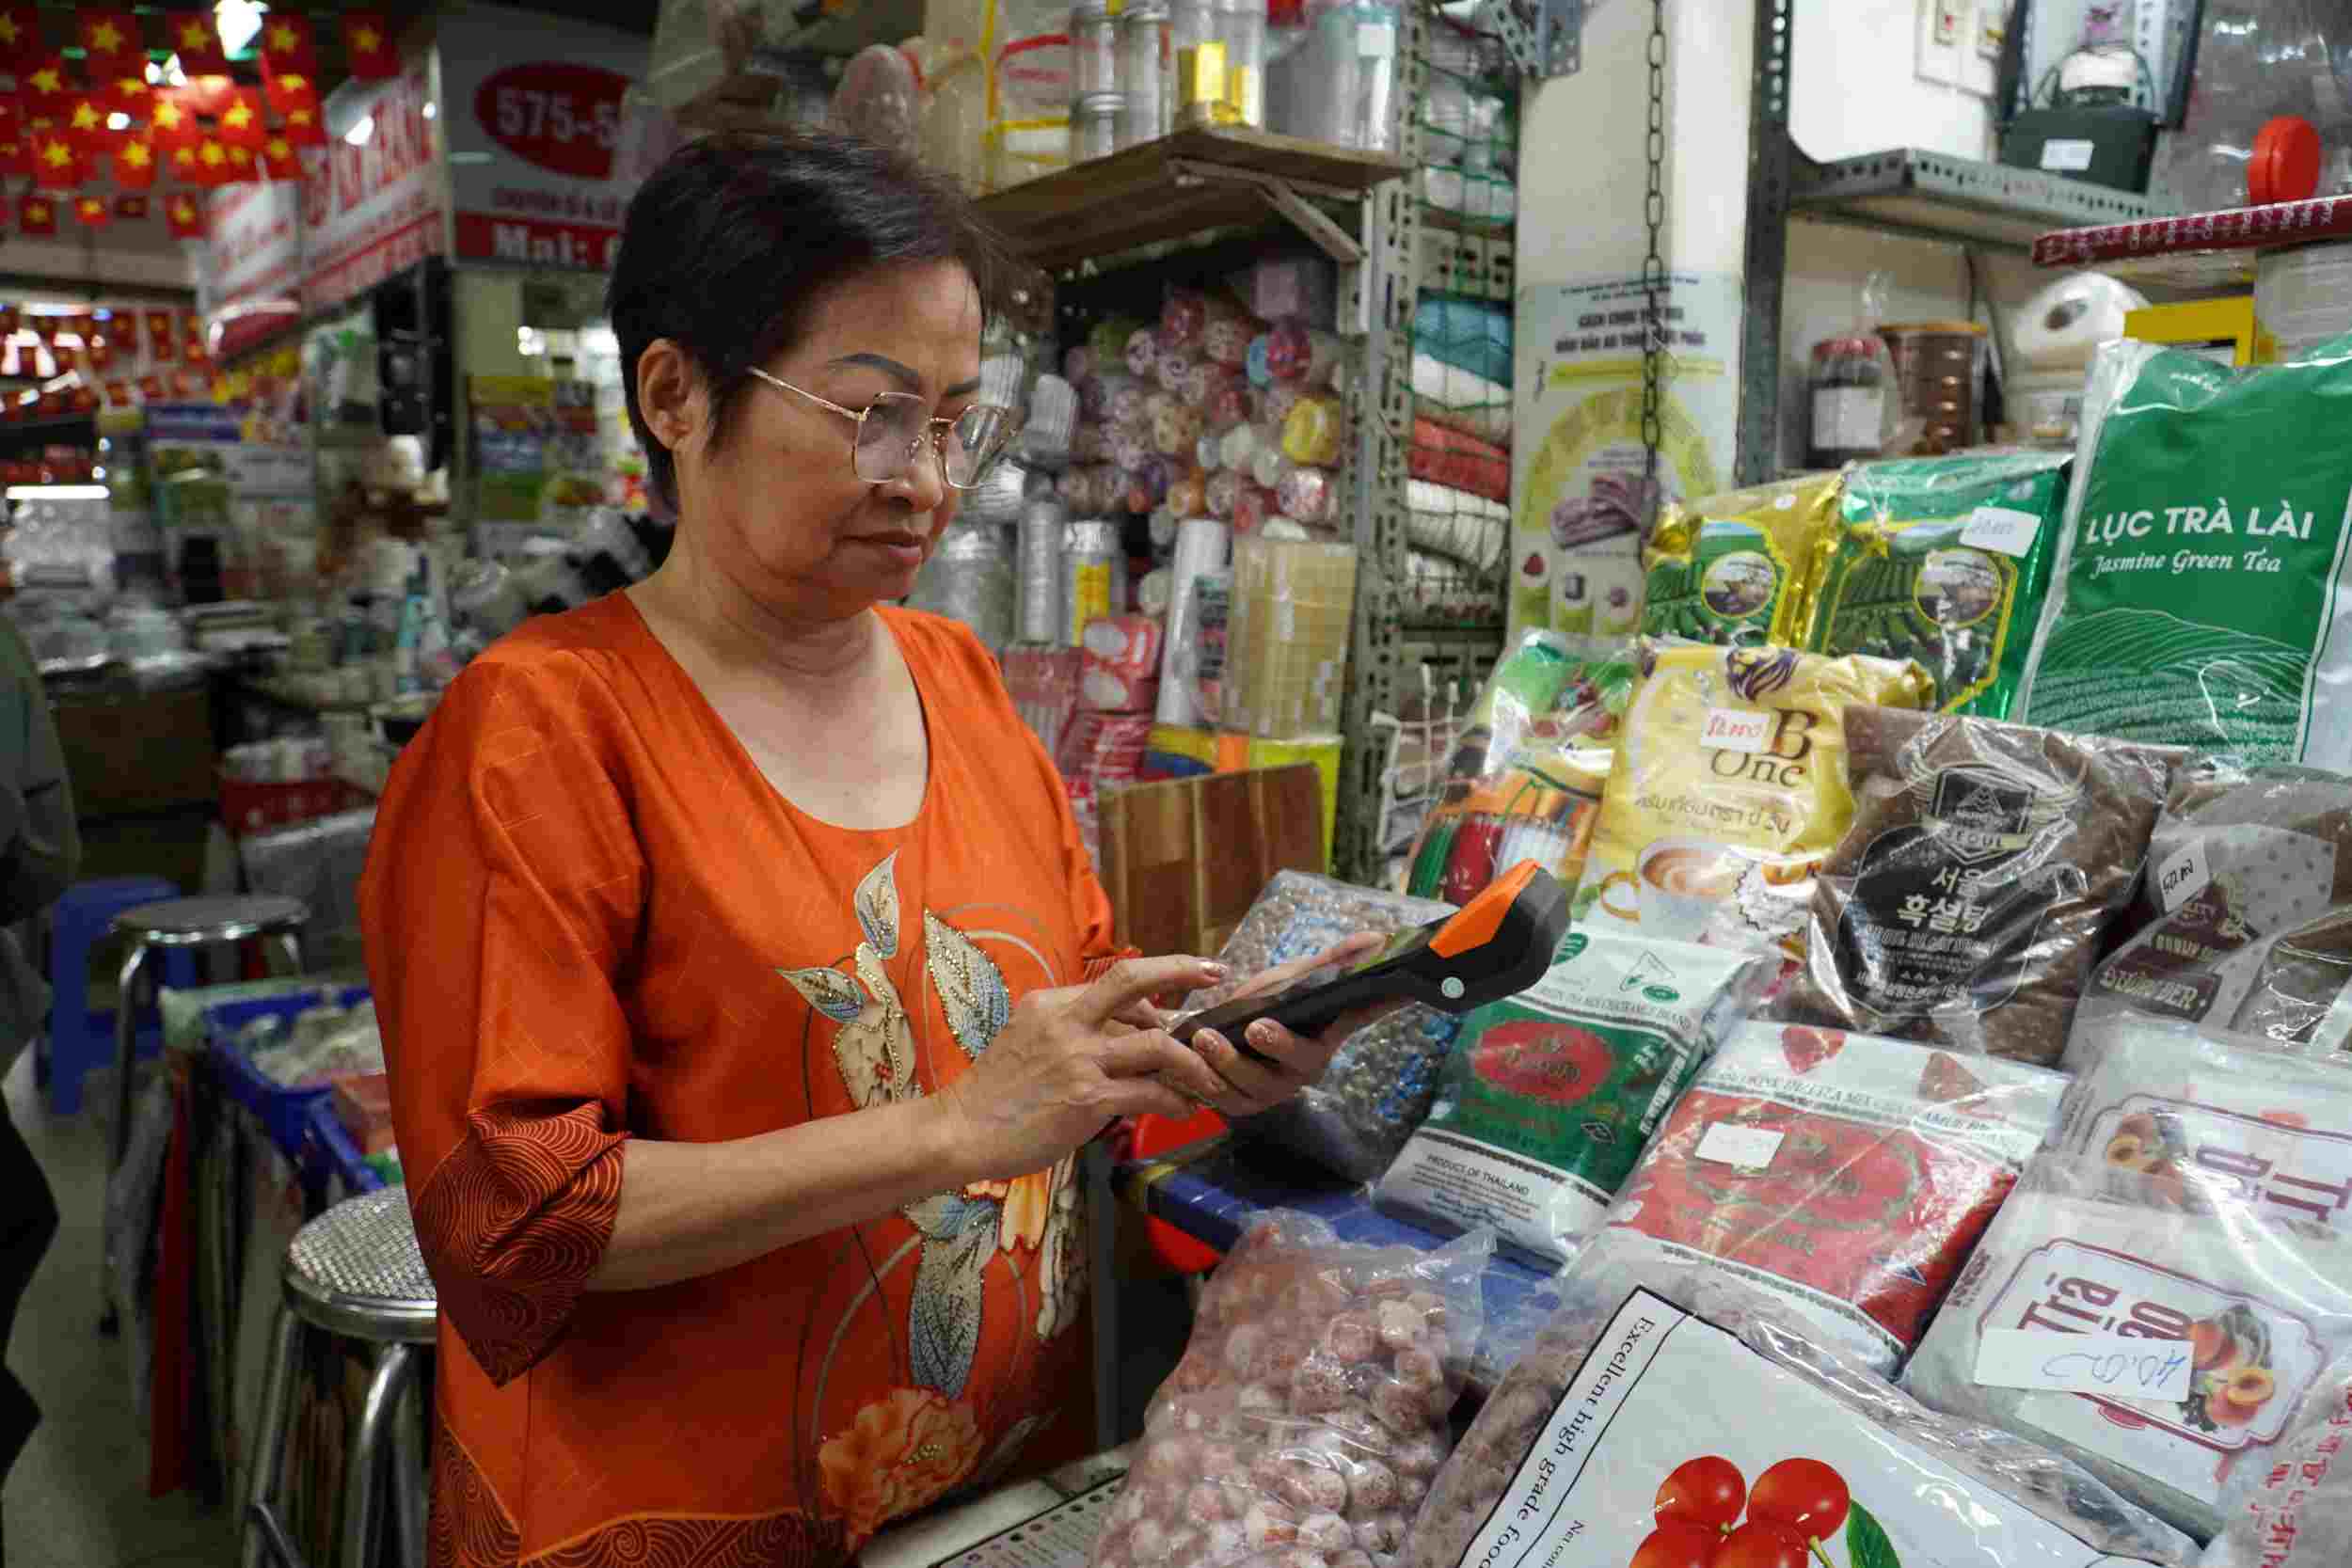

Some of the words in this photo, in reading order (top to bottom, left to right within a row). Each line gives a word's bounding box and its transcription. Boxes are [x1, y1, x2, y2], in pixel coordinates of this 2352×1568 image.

[2085, 510, 2154, 546] LỤC
[2165, 497, 2233, 535] TRÀ
[2246, 499, 2315, 540] LÀI
[2091, 551, 2165, 579] Jasmine
[2171, 548, 2233, 575] Green
[2242, 546, 2281, 573] Tea
[1769, 707, 1820, 761] B
[1710, 749, 1807, 789] One
[1931, 866, 1981, 898] 서울
[1898, 894, 1992, 933] 흑설탕
[1426, 1153, 1467, 1176] PRODUCT
[1468, 1164, 1482, 1178] OF
[1483, 1171, 1531, 1197] THAILAND
[2017, 1271, 2122, 1334] Trà
[1587, 1316, 1656, 1407] Excellent
[1555, 1411, 1594, 1457] high
[1517, 1457, 1557, 1522] grade
